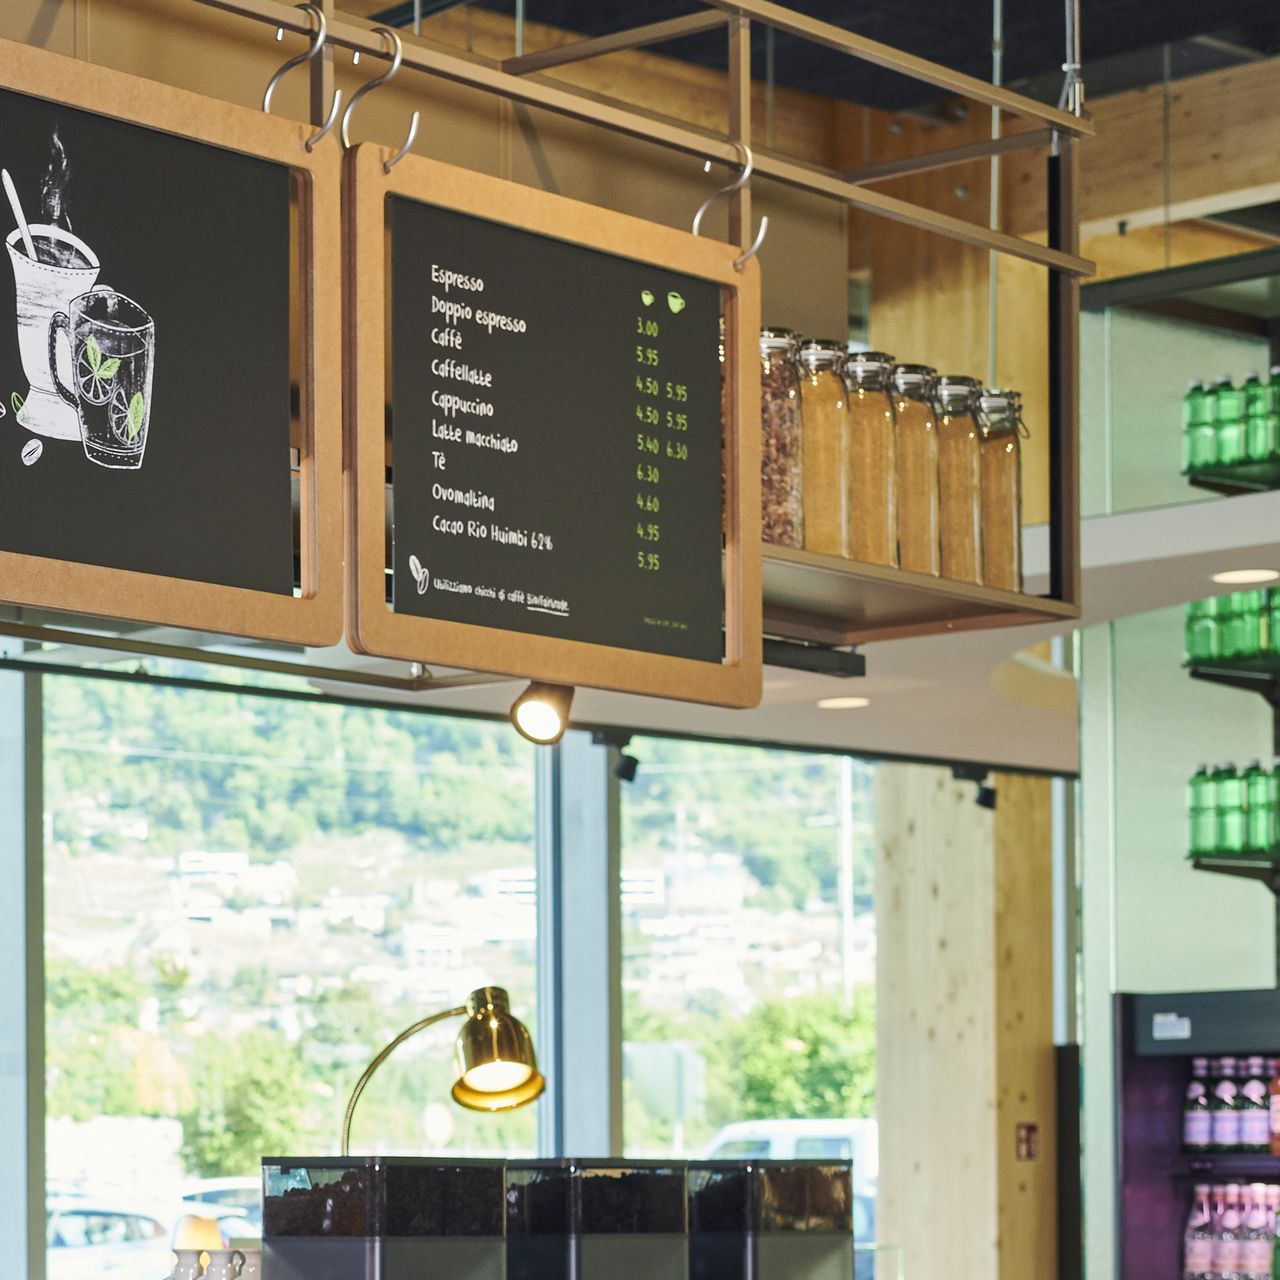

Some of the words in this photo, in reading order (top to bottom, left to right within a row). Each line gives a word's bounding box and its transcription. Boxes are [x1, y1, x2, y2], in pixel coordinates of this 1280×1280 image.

[431, 264, 484, 292] Espresso
[637, 316, 659, 337] 3.00
[431, 295, 472, 325] Doppio
[475, 309, 527, 334] espresso
[636, 346, 659, 366] 5.95
[431, 328, 463, 350] Caffè
[636, 376, 659, 396] 4.50
[666, 382, 688, 402] 5.95
[431, 359, 492, 387] Caffellatte
[636, 405, 659, 425] 4.50
[666, 411, 688, 431] 5.95
[431, 390, 494, 418] Cappuccino
[636, 434, 659, 454] 5.40
[666, 440, 688, 460] 6.30
[432, 419, 462, 442] Latte
[466, 429, 519, 452] macchiato
[636, 464, 659, 483] 6.30
[432, 451, 446, 470] Tè
[636, 493, 659, 512] 4.60
[432, 483, 495, 511] Ovomaltina
[636, 523, 660, 541] 4.95
[432, 515, 464, 535] Cacao
[468, 520, 487, 538] Rio
[491, 524, 528, 547] Huimbi
[531, 531, 553, 551] 62%
[638, 551, 660, 571] 5.95
